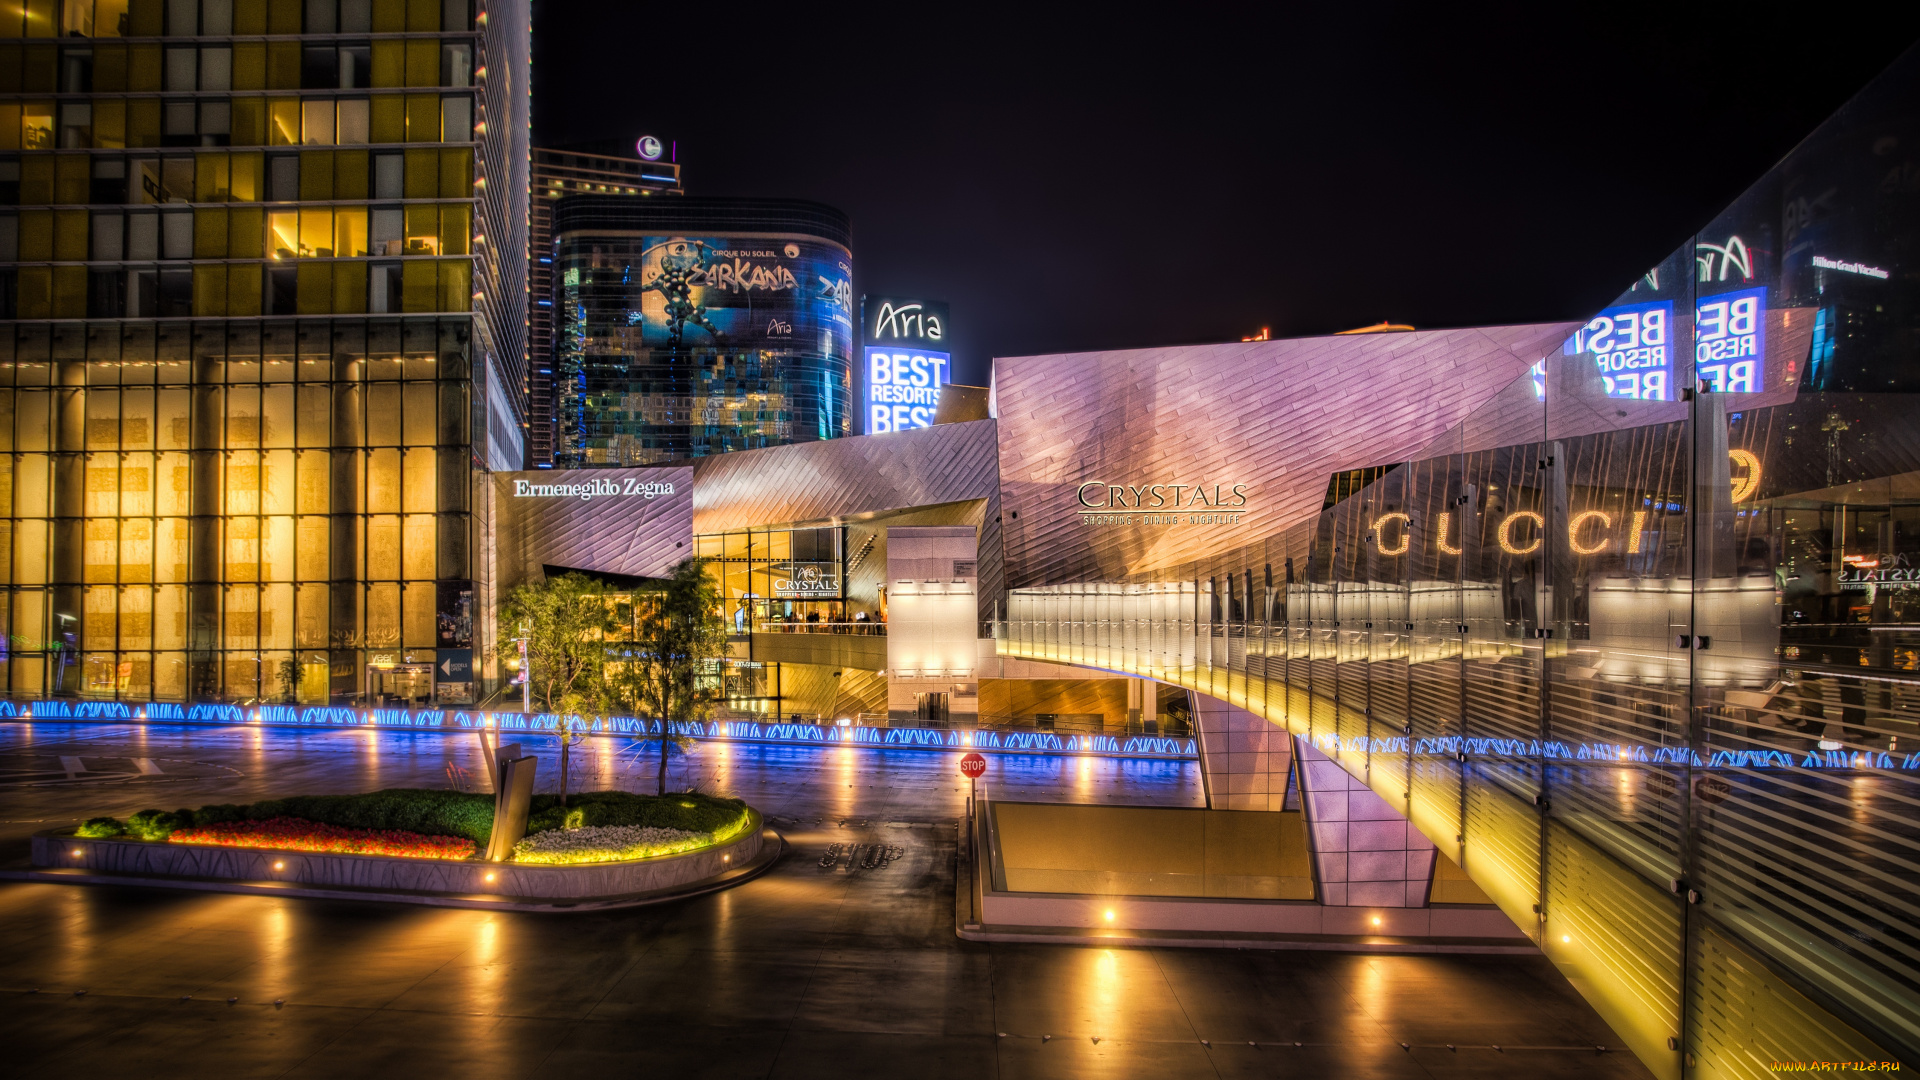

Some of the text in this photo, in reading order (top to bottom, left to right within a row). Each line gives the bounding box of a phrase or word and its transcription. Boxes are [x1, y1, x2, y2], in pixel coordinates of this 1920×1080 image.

[712, 250, 738, 258] CIRQUE
[752, 250, 777, 258] SOLEIL
[686, 258, 799, 294] ZARKANA
[1812, 256, 1889, 279] Hilton Grand Vacations
[767, 318, 792, 335] Aria
[875, 302, 942, 339] Aria
[871, 353, 946, 388] BEST
[871, 385, 941, 406] RESORTS
[513, 478, 675, 501] Ermenegildo Zegna
[1077, 481, 1247, 508] CRYSTALS
[1083, 514, 1240, 526] SHOPPING DINING NIGHTLIFE
[774, 578, 839, 590] CRYSTALS
[961, 761, 985, 771] STOP
[818, 843, 904, 869] STOP
